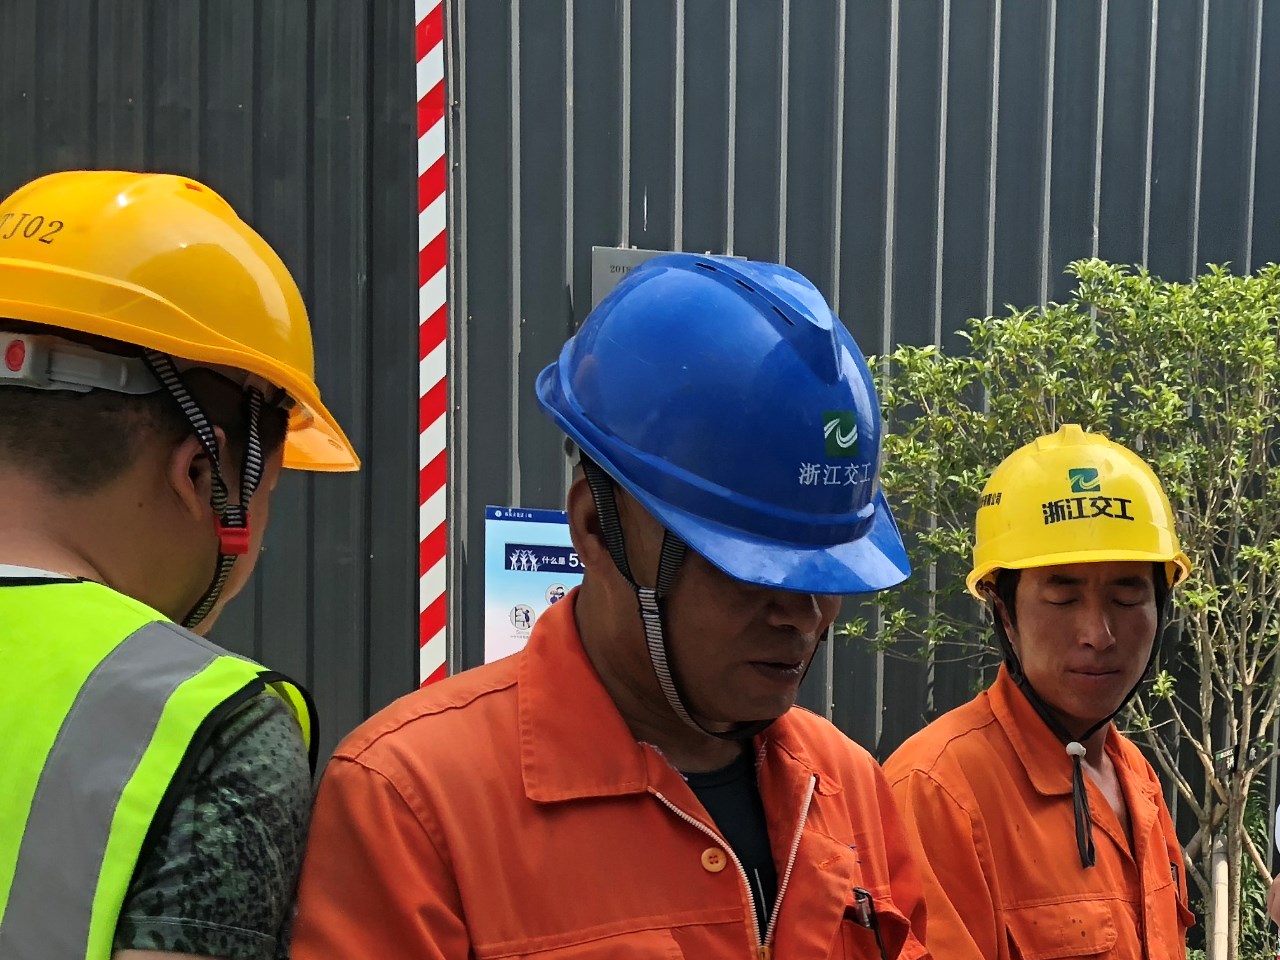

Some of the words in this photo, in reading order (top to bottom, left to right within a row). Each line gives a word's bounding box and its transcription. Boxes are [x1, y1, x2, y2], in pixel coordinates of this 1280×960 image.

[799, 462, 871, 486] 浙江交工
[1042, 495, 1135, 525] 浙江交工
